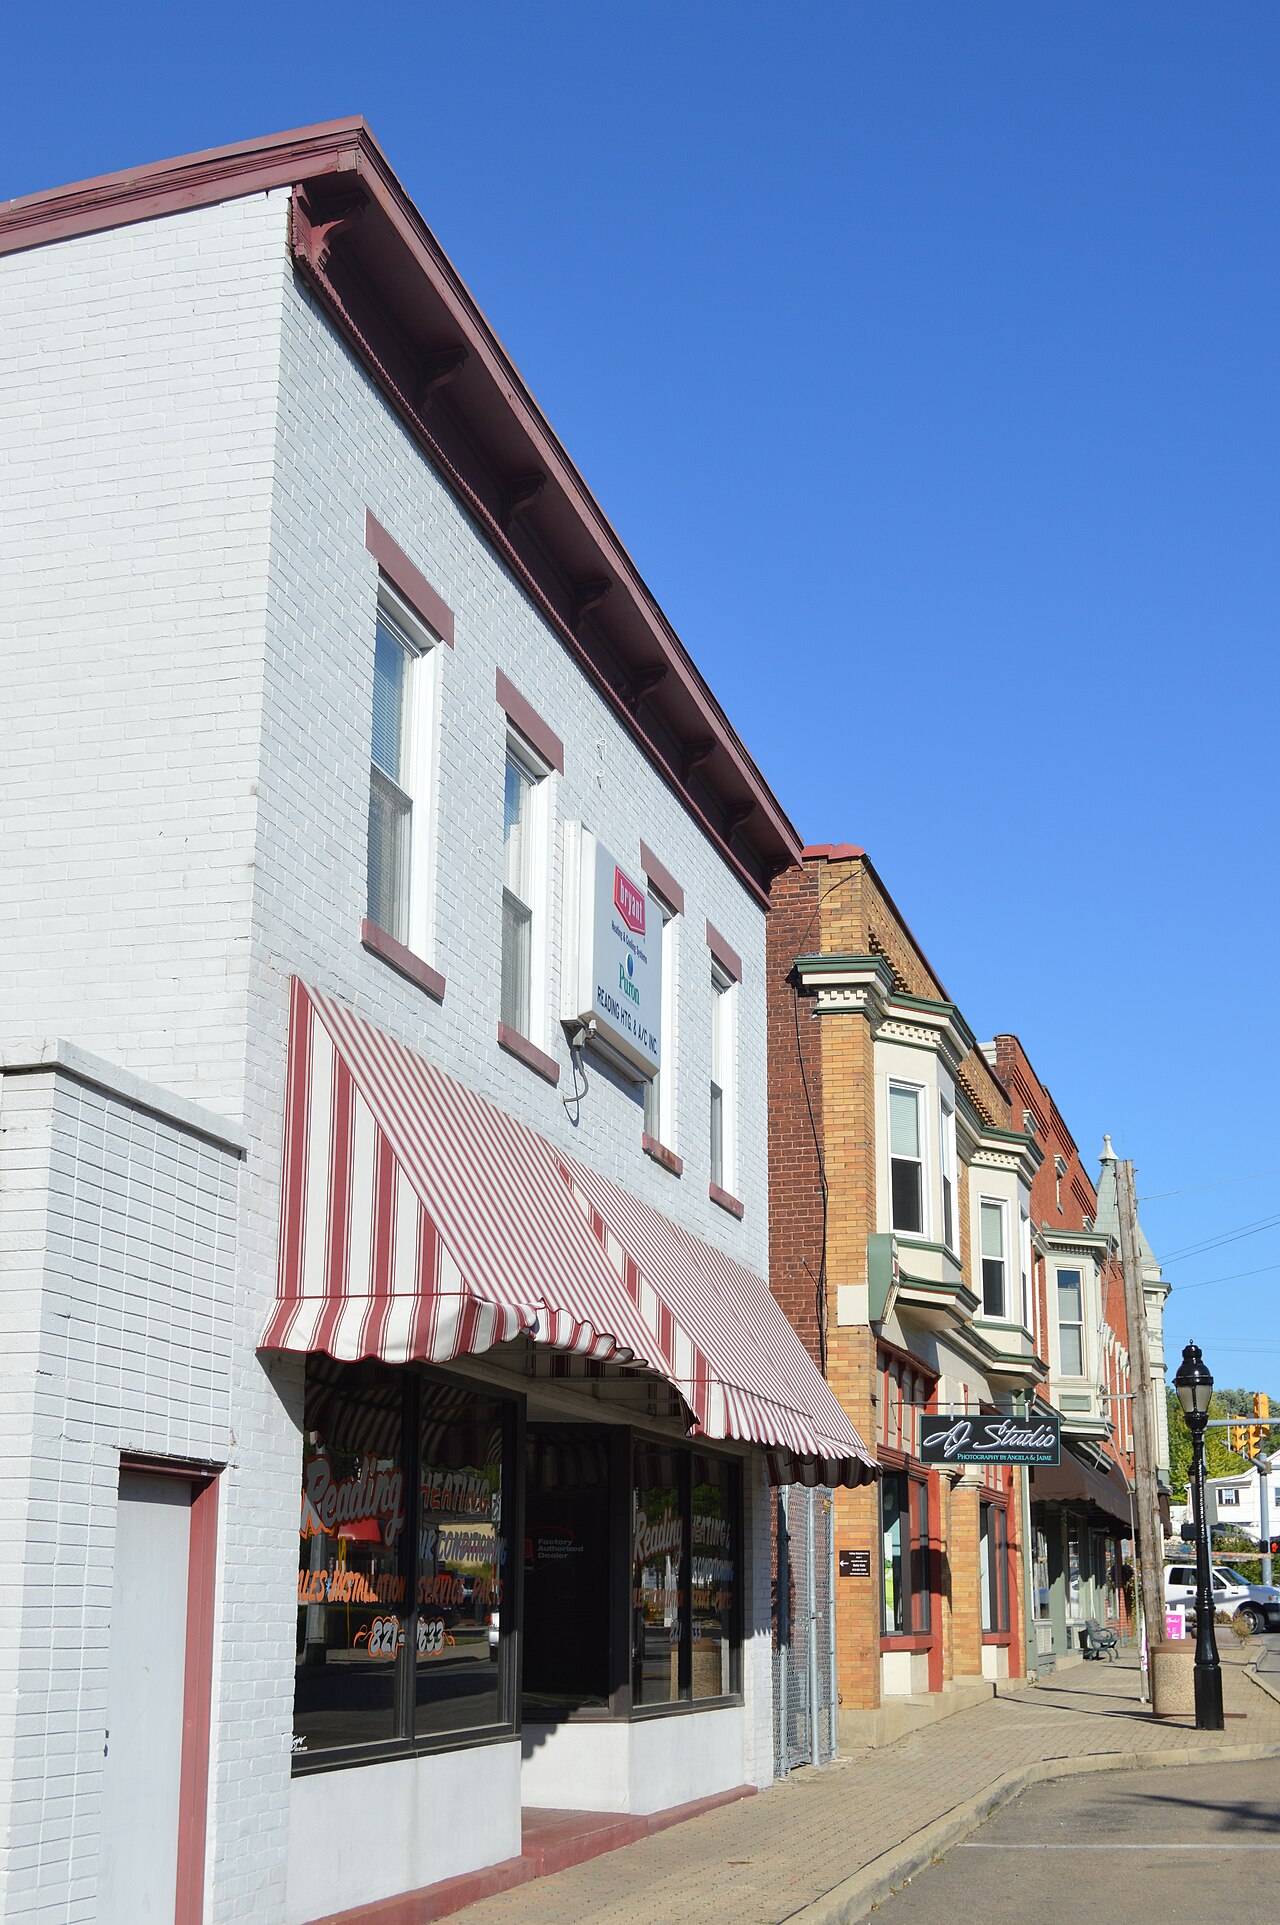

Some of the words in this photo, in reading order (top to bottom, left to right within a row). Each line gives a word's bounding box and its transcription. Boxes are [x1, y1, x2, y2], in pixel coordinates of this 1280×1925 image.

[620, 878, 643, 925] bryant
[619, 962, 640, 1006] Puron
[597, 985, 620, 1020] READING
[620, 1006, 632, 1032] HTG
[633, 1019, 637, 1036] &
[638, 1023, 648, 1046] A/C
[923, 1419, 971, 1458] AJ
[972, 1419, 1056, 1450] Studio
[1036, 1454, 1053, 1462] JAIME
[299, 1455, 406, 1548] Reading
[420, 1470, 492, 1514] HEATING
[437, 1530, 508, 1566] CONDITIONING
[633, 1506, 682, 1568] Reading
[328, 1569, 407, 1604] INSTALLATION
[417, 1575, 466, 1605] SERVICE
[471, 1577, 504, 1606] PARTS
